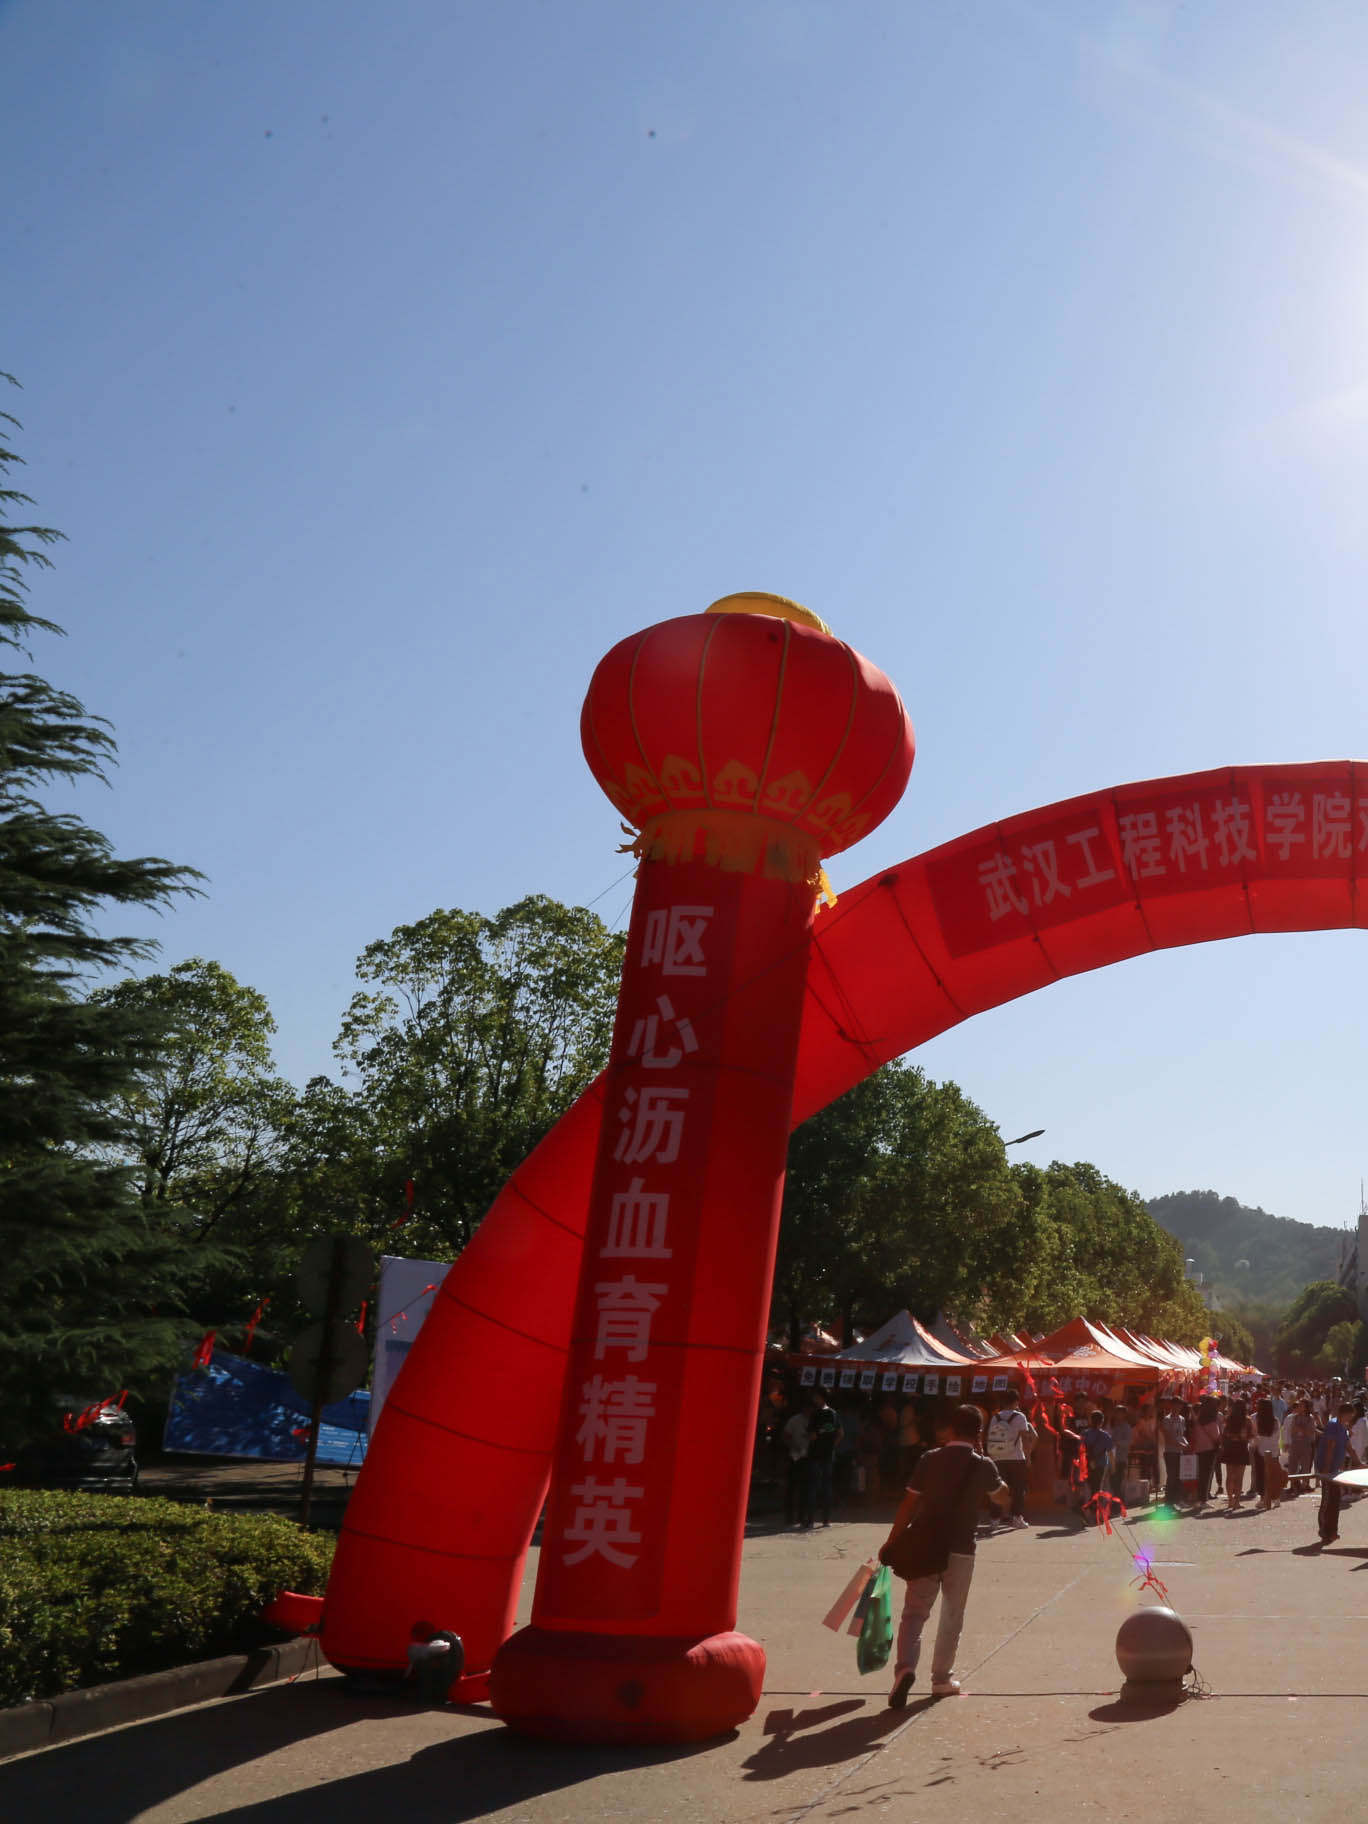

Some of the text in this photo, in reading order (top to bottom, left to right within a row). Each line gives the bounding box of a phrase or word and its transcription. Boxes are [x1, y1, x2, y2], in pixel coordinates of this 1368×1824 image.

[562, 904, 714, 1569] 呕心沥血育精英
